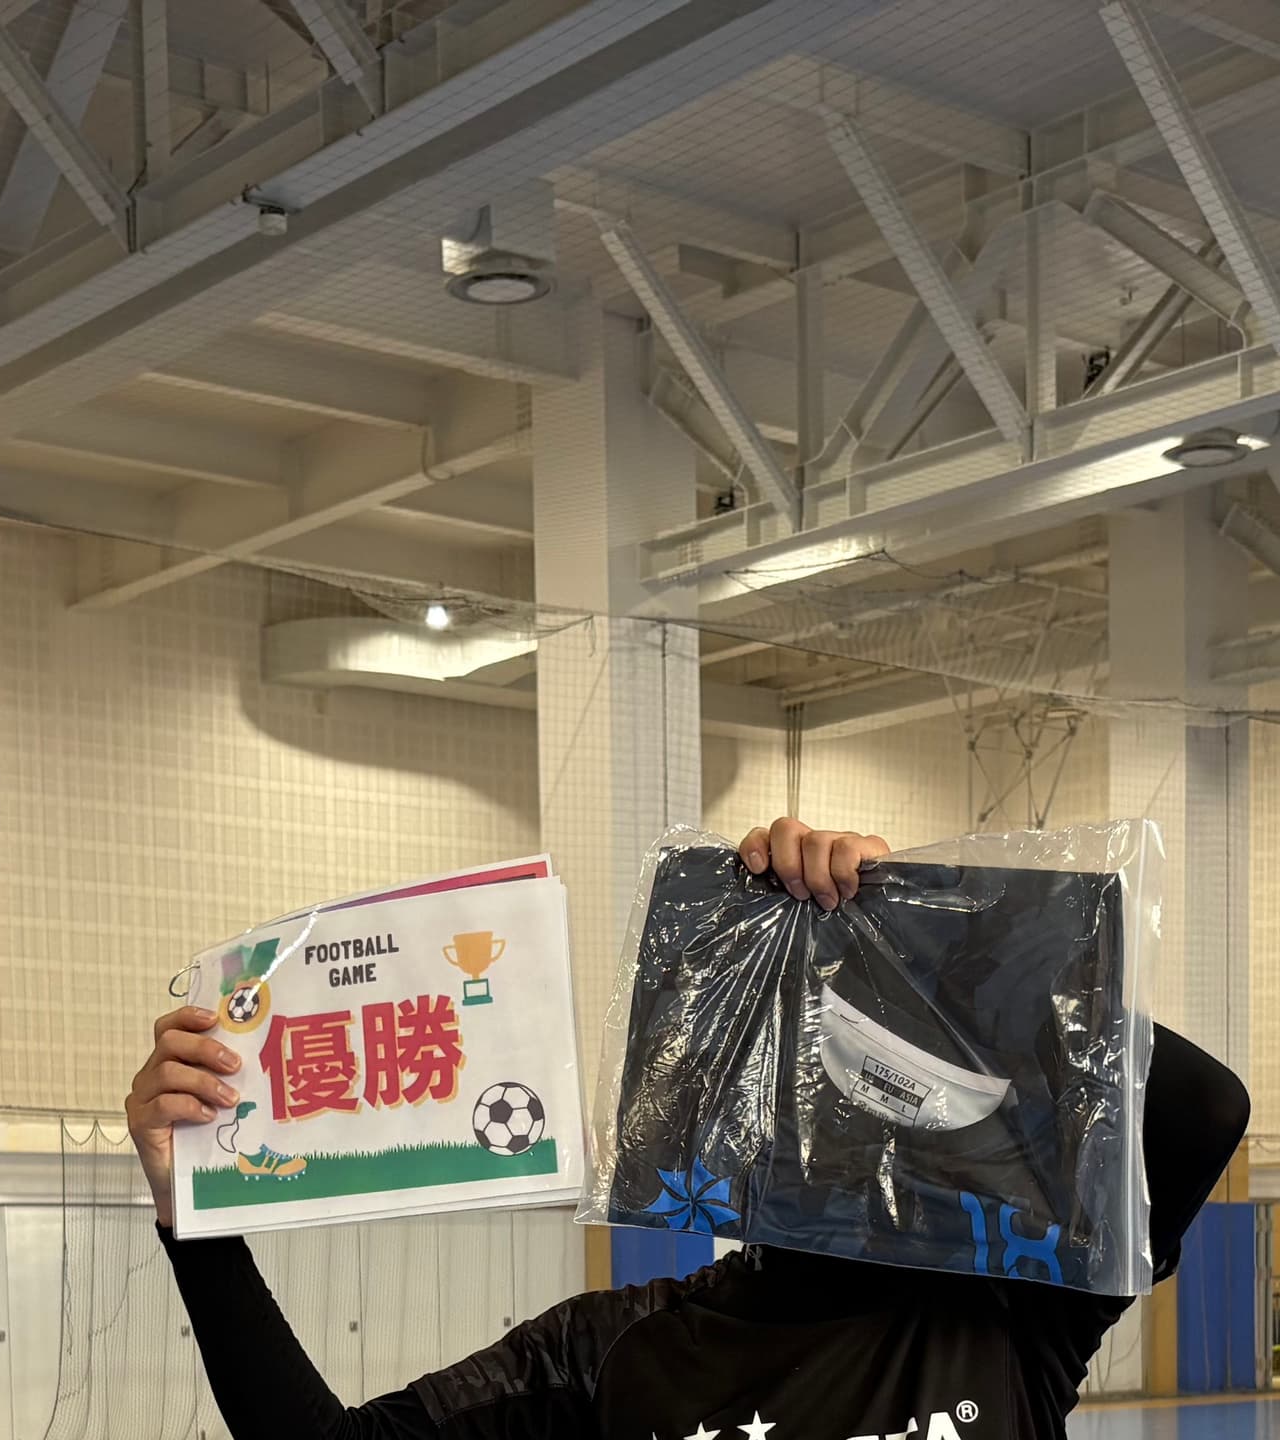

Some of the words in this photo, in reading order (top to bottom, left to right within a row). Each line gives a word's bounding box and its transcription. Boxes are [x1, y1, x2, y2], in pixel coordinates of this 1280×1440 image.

[305, 934, 400, 965] FOOTBALL
[329, 963, 377, 988] GAME
[259, 994, 468, 1123] 優勝
[874, 1064, 916, 1091] 175/102A
[860, 1083, 870, 1094] M
[880, 1093, 889, 1104] M
[899, 1091, 918, 1106] ASIA
